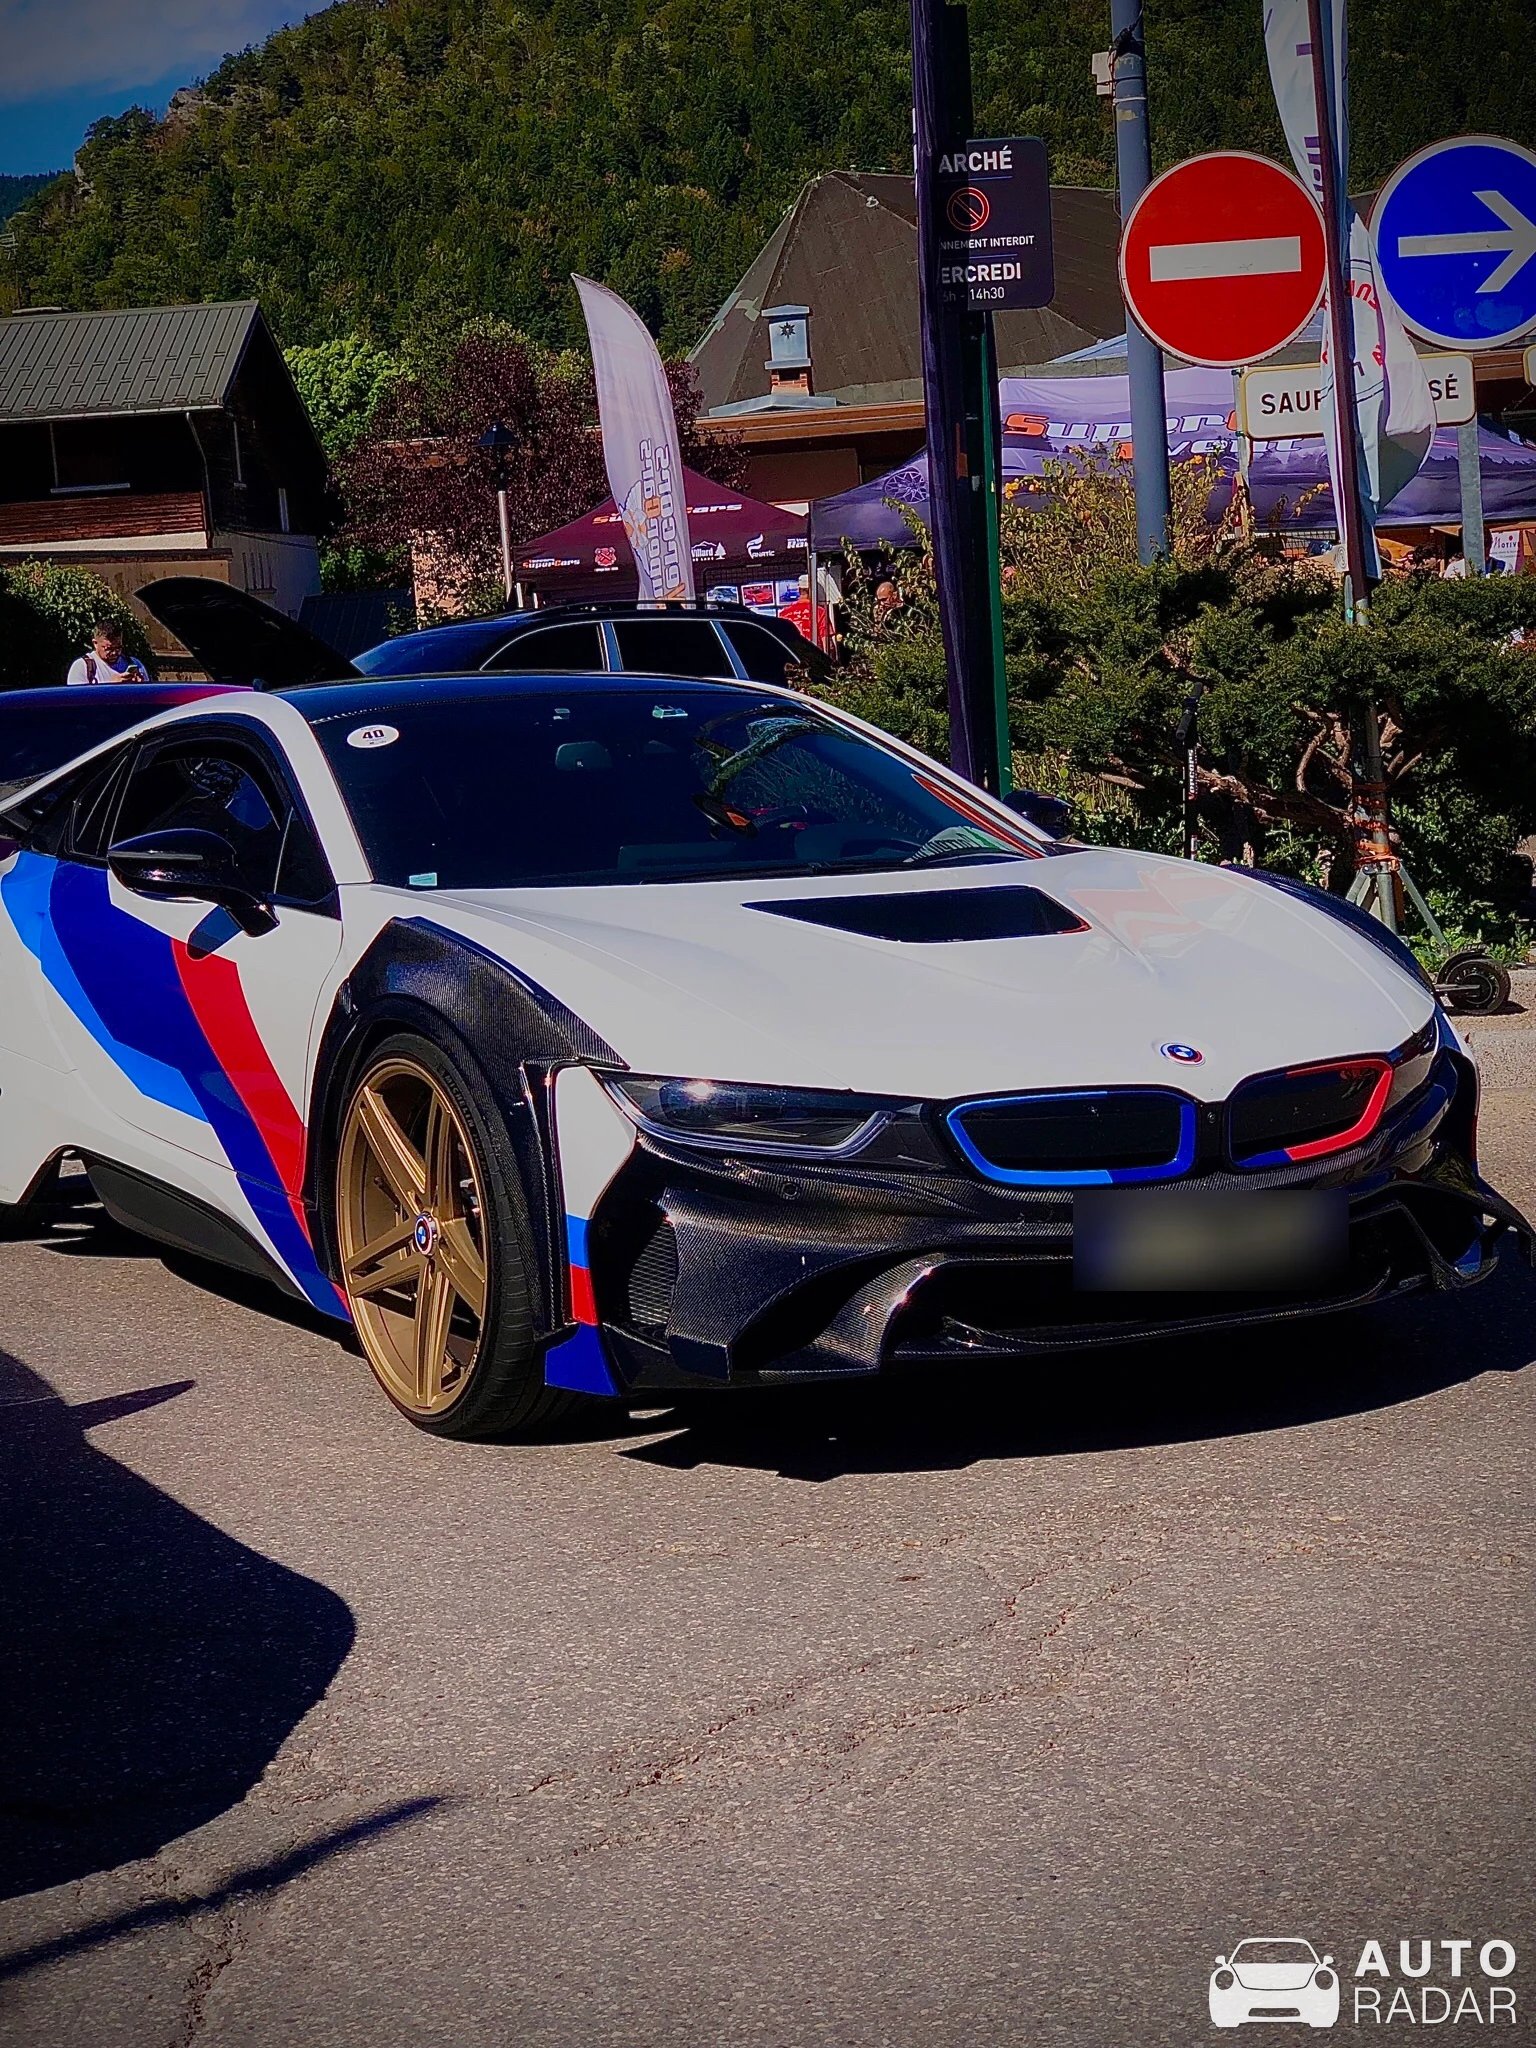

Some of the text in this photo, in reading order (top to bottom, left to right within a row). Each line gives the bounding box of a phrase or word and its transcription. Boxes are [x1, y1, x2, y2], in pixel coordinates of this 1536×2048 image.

[938, 145, 1013, 174] ARCHÉ
[940, 235, 1035, 250] NNEMENT INTERDIT
[941, 262, 1022, 285] ERCREDI
[969, 286, 1005, 301] 14h30
[1428, 373, 1460, 401] SÉ
[362, 729, 385, 740] 40
